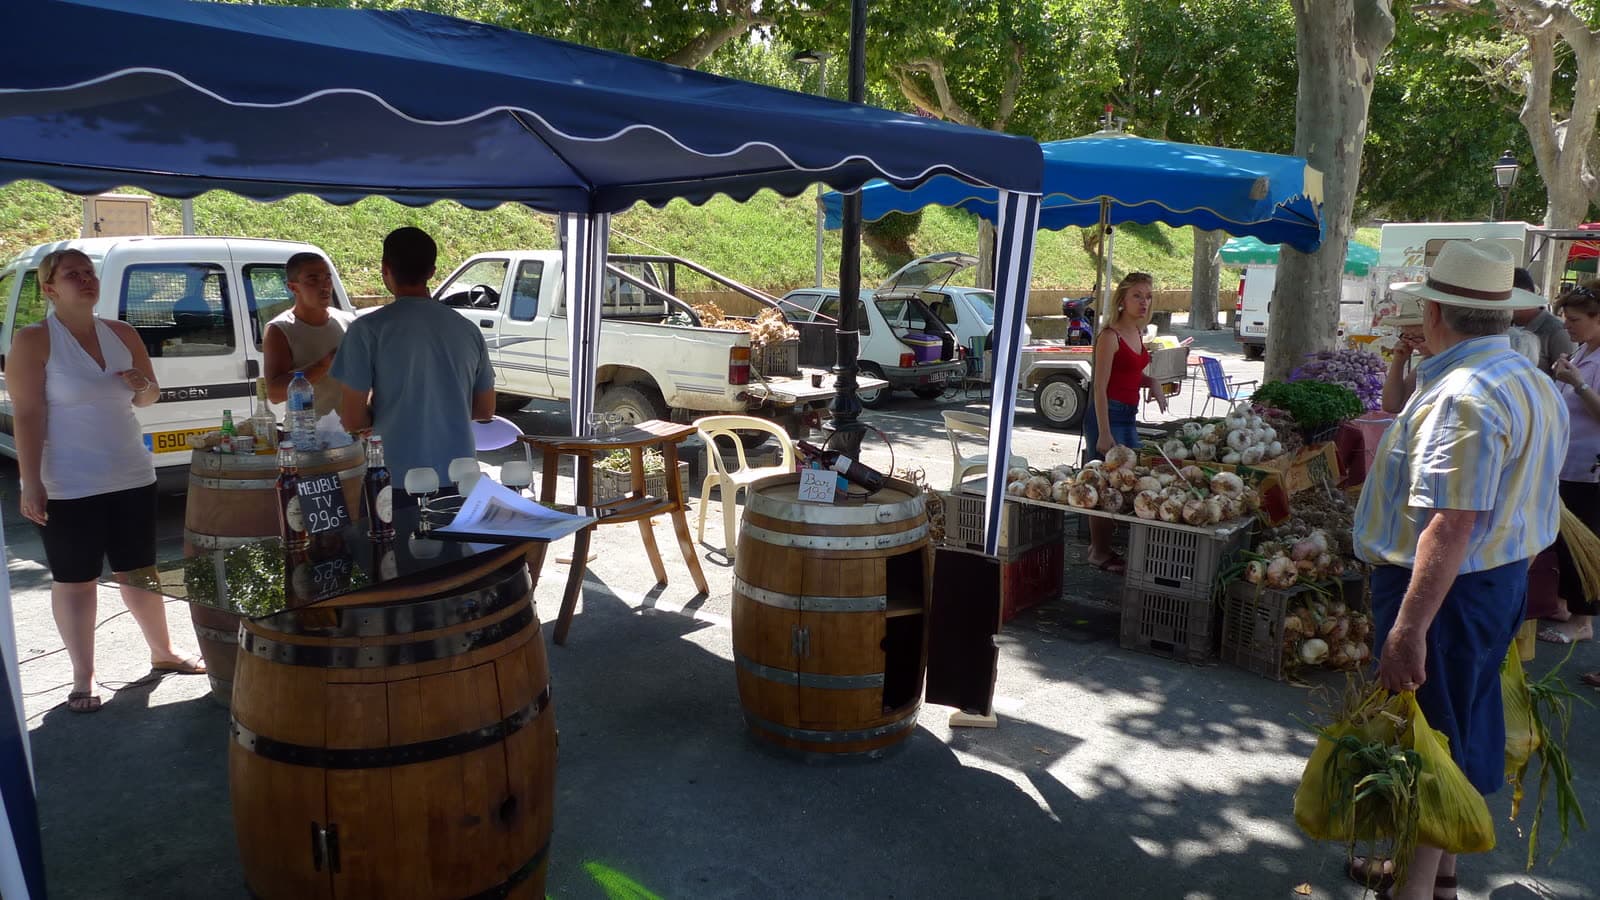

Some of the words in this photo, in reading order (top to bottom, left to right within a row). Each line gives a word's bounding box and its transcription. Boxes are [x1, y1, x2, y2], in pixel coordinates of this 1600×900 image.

[160, 387, 208, 400] TROËN
[297, 475, 341, 496] MEUBLE
[312, 494, 332, 509] TV
[309, 505, 347, 534] 290€
